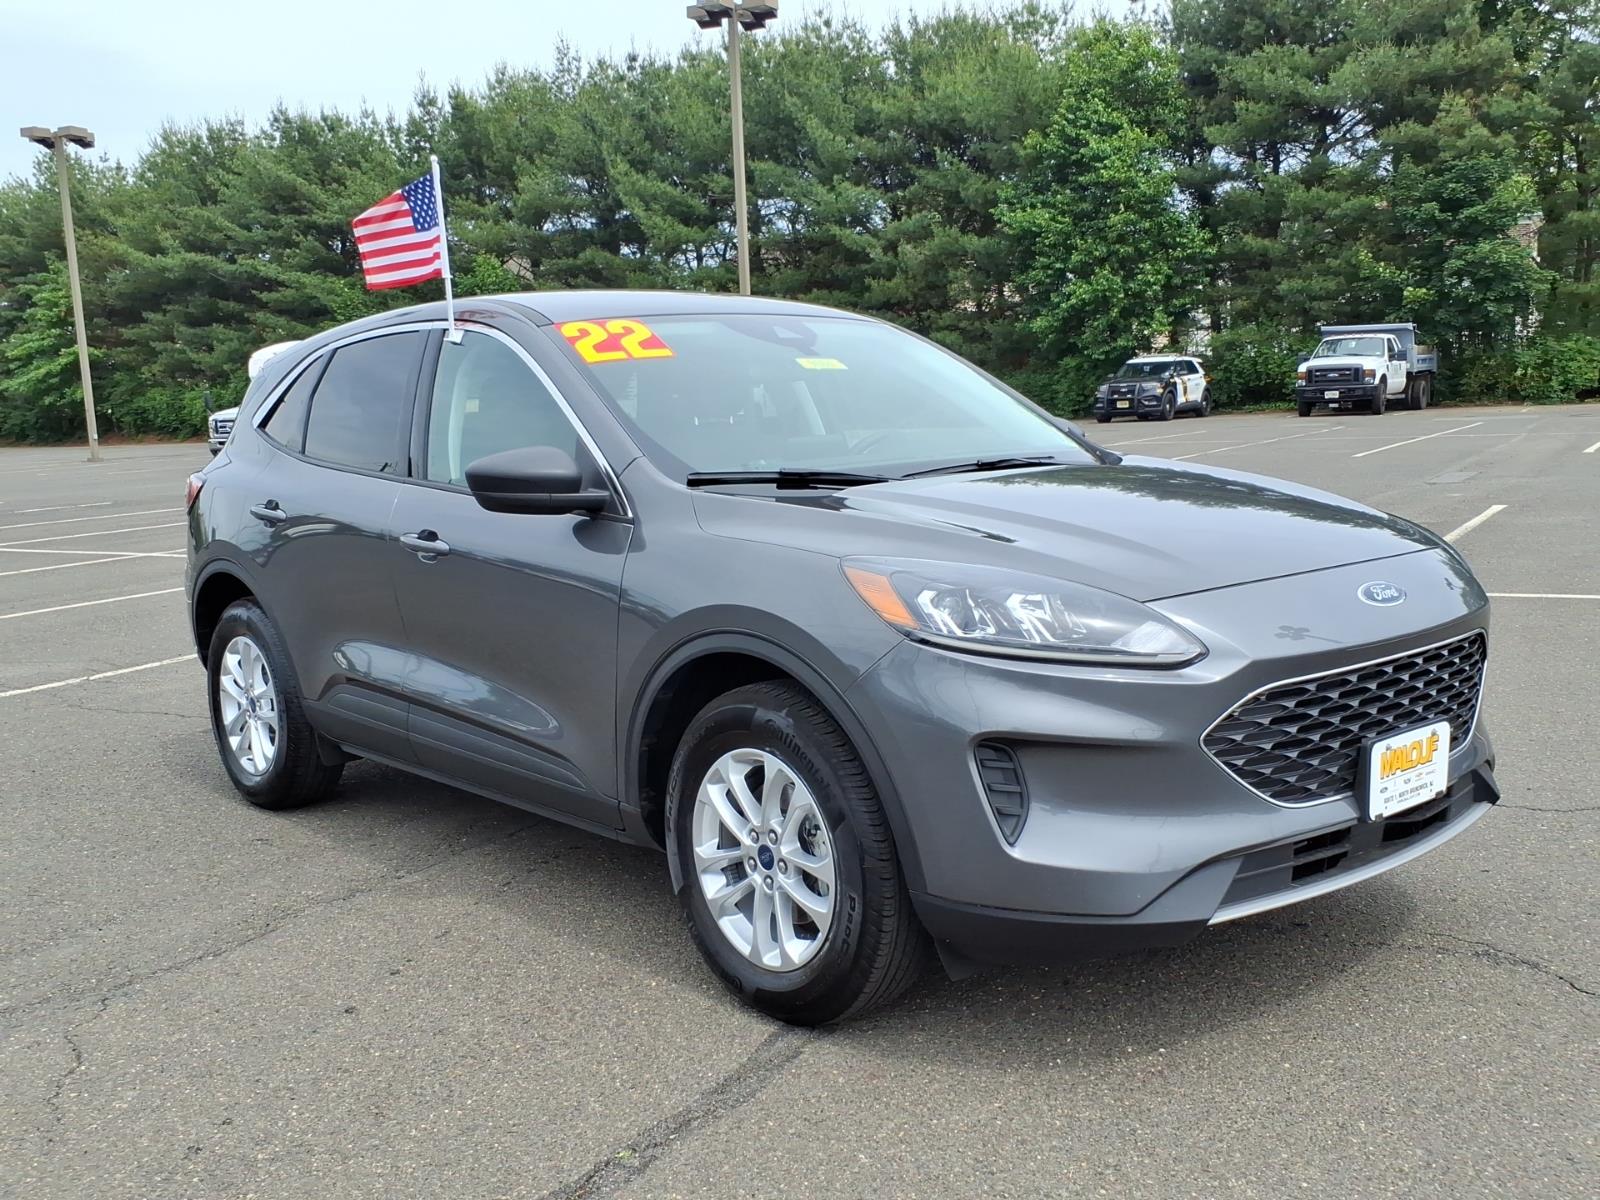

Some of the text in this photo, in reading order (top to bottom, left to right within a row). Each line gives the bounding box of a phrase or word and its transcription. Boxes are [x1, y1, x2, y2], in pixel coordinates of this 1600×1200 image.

[560, 320, 673, 363] 22
[1370, 585, 1399, 600] Ford
[1380, 734, 1440, 779] MALOUF
